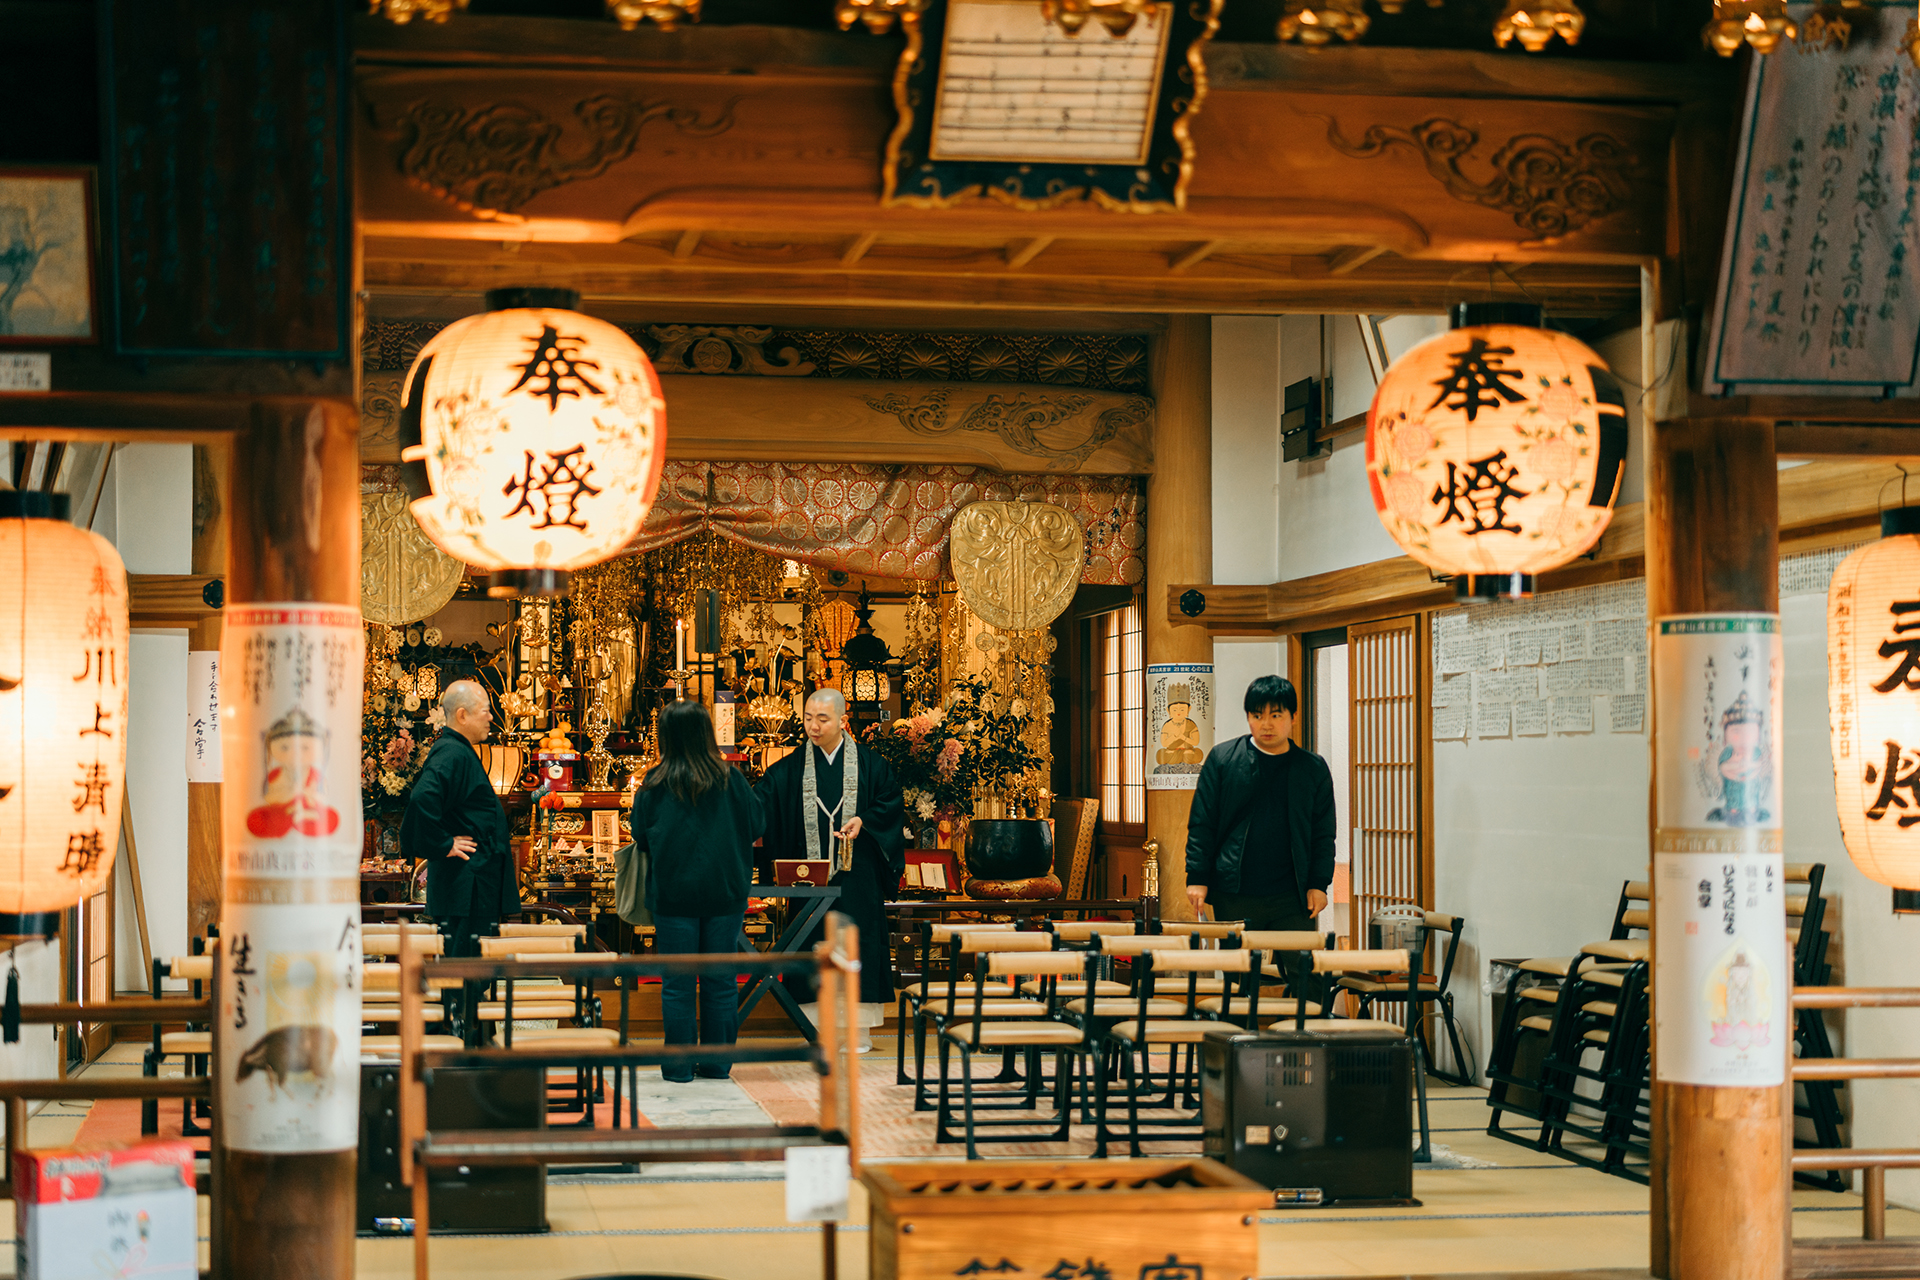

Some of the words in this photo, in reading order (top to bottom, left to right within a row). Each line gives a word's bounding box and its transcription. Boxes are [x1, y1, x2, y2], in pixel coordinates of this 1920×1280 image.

[502, 323, 606, 531] 奉燈
[1424, 337, 1532, 535] 奉燈
[193, 718, 206, 760] 合掌
